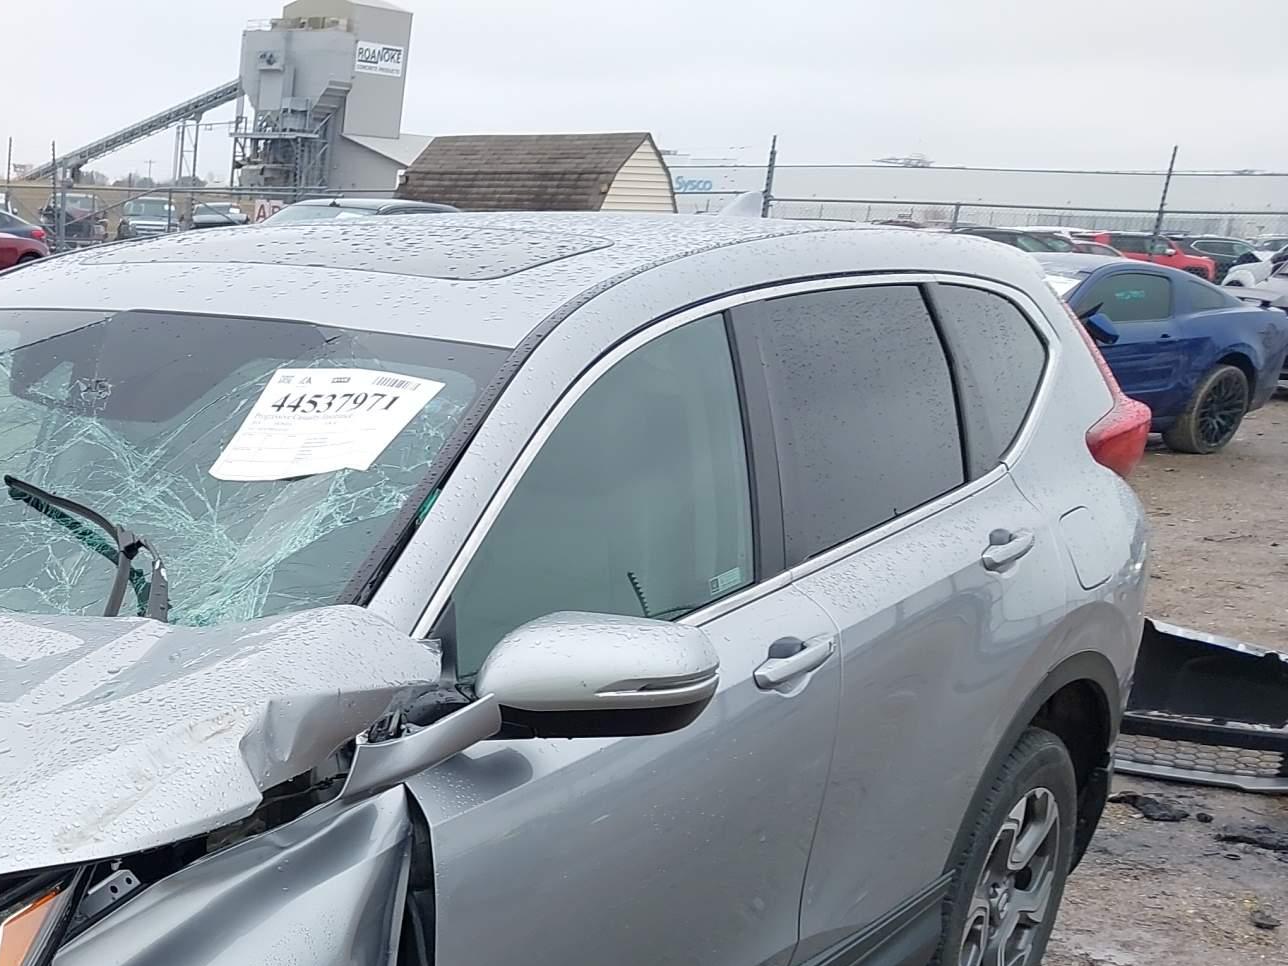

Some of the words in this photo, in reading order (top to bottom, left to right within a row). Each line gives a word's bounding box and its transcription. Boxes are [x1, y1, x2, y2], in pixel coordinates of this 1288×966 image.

[357, 47, 402, 64] ROANOKE
[675, 175, 713, 192] Sysco
[271, 392, 401, 414] 44537971
